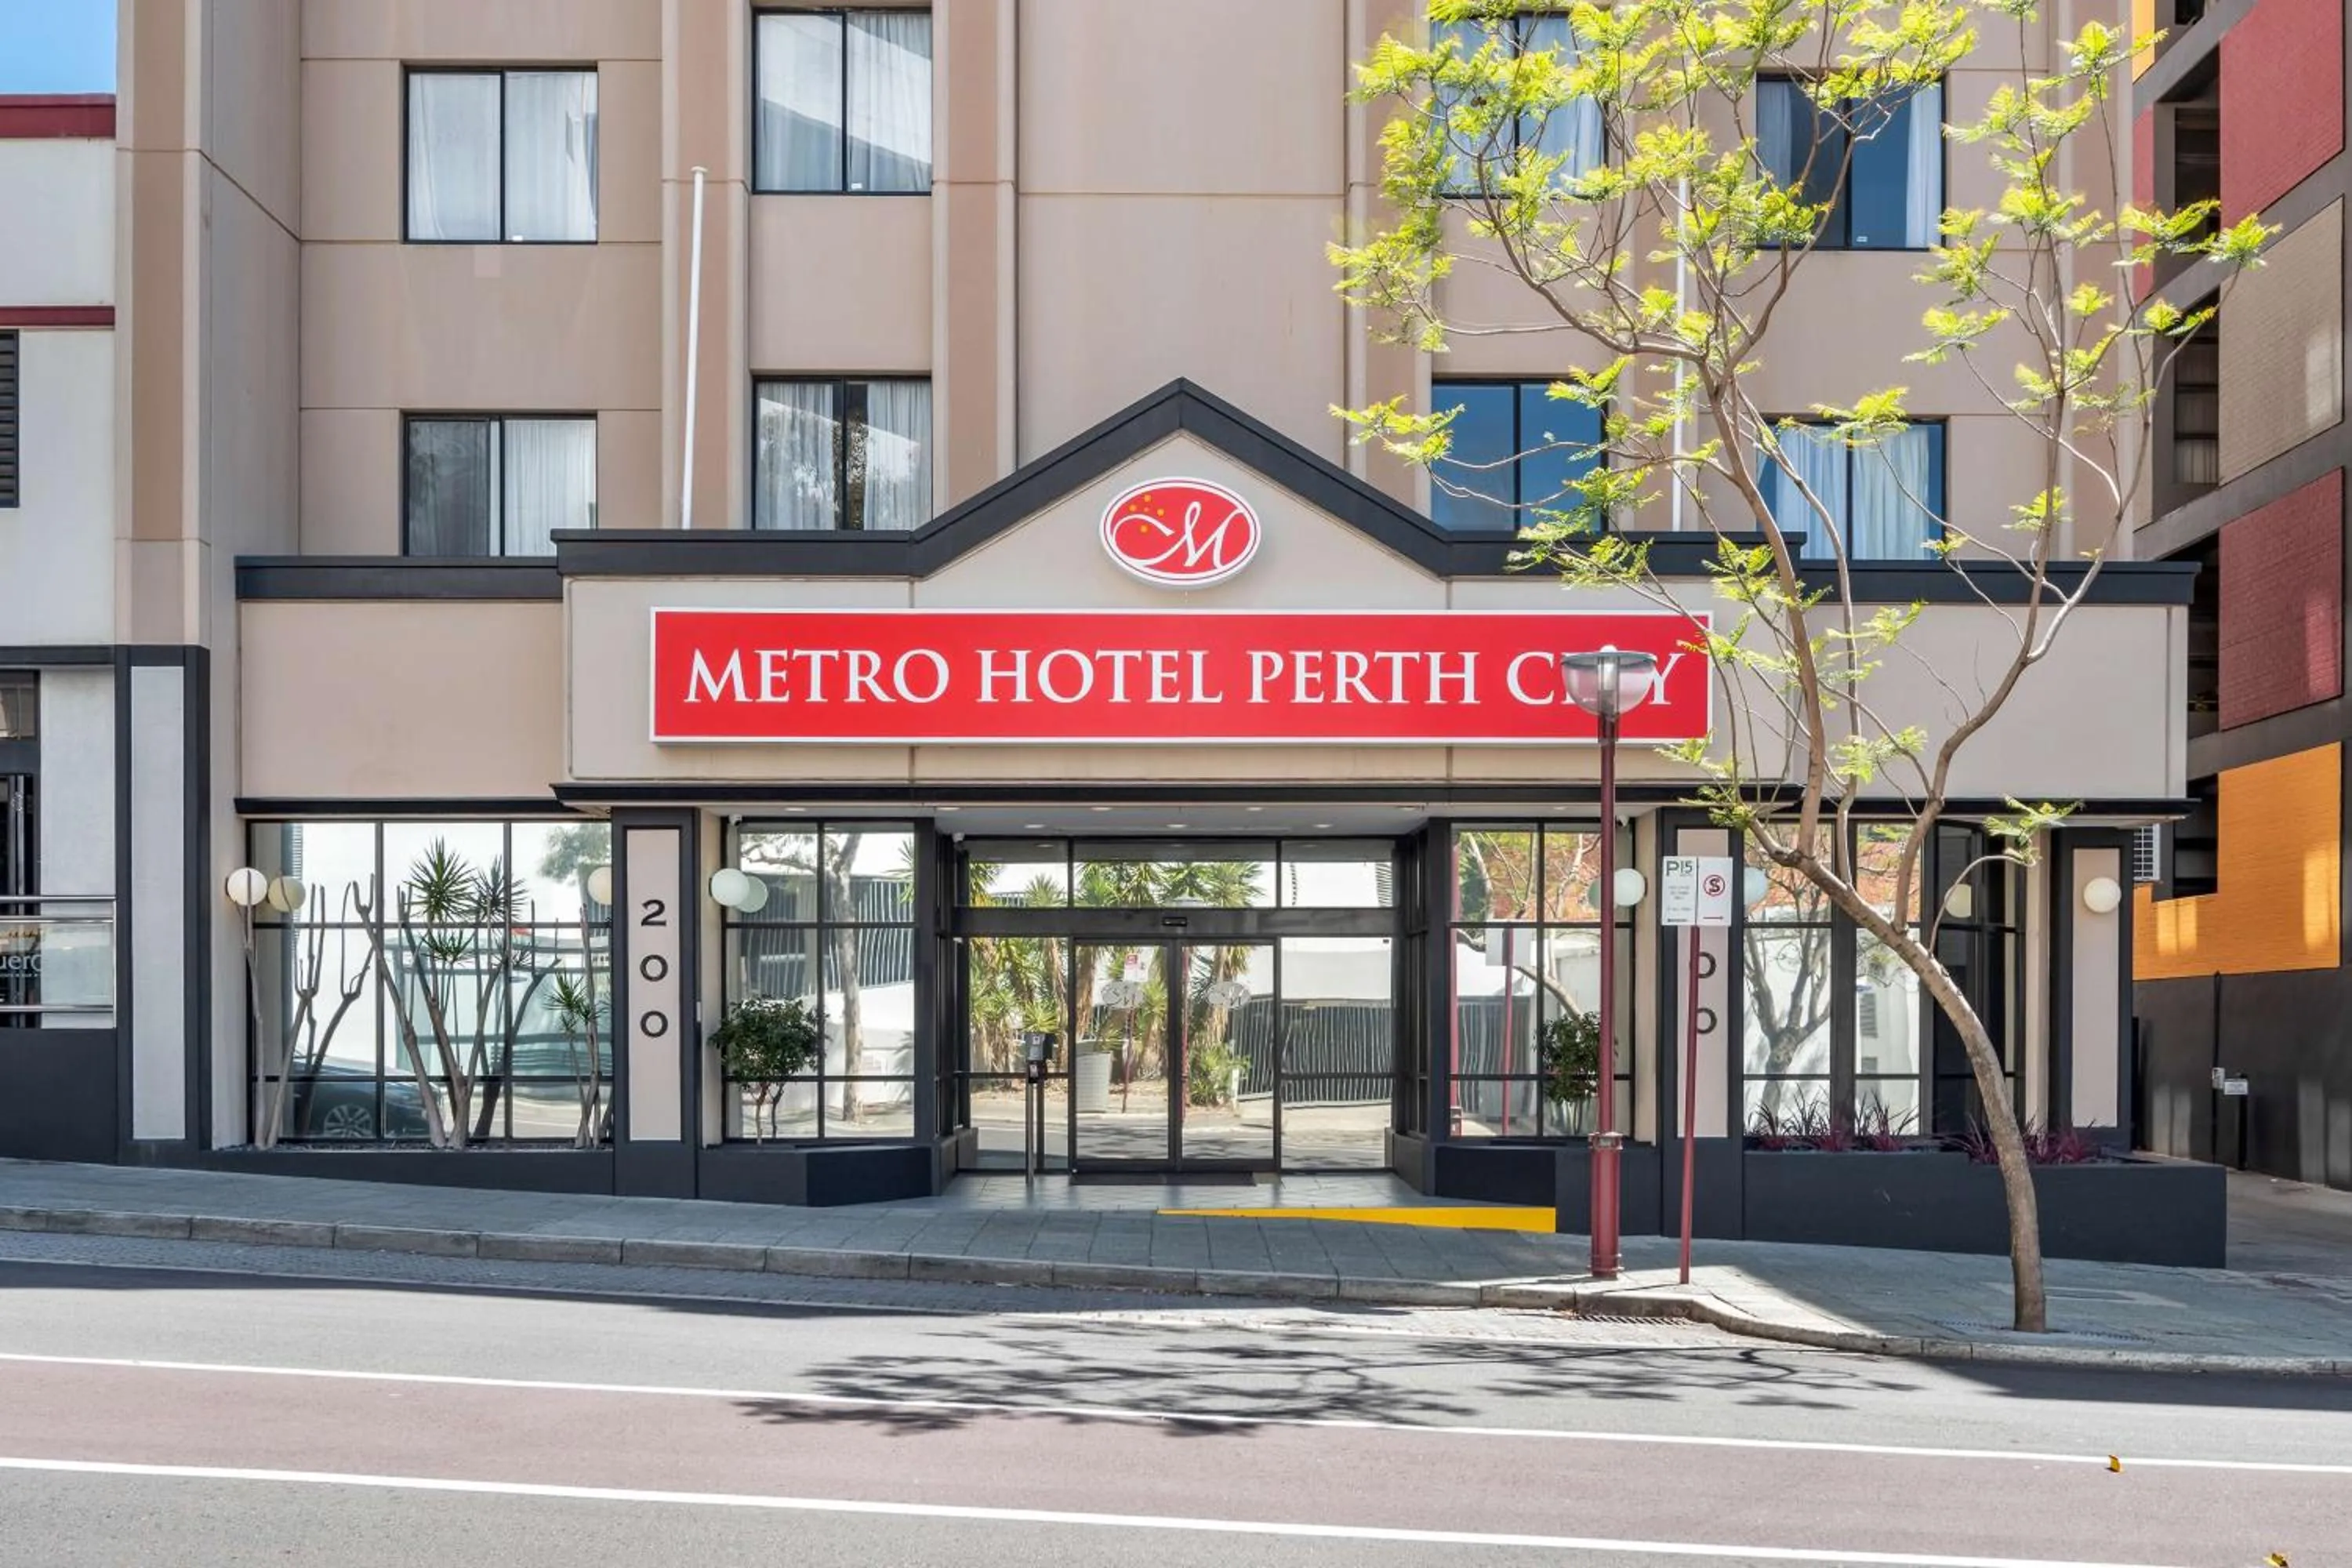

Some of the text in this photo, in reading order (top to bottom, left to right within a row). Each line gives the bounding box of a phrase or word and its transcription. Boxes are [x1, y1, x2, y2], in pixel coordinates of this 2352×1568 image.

[684, 649, 1684, 704] METRO HOTEL PERTH CY
[641, 900, 668, 1037] 200
